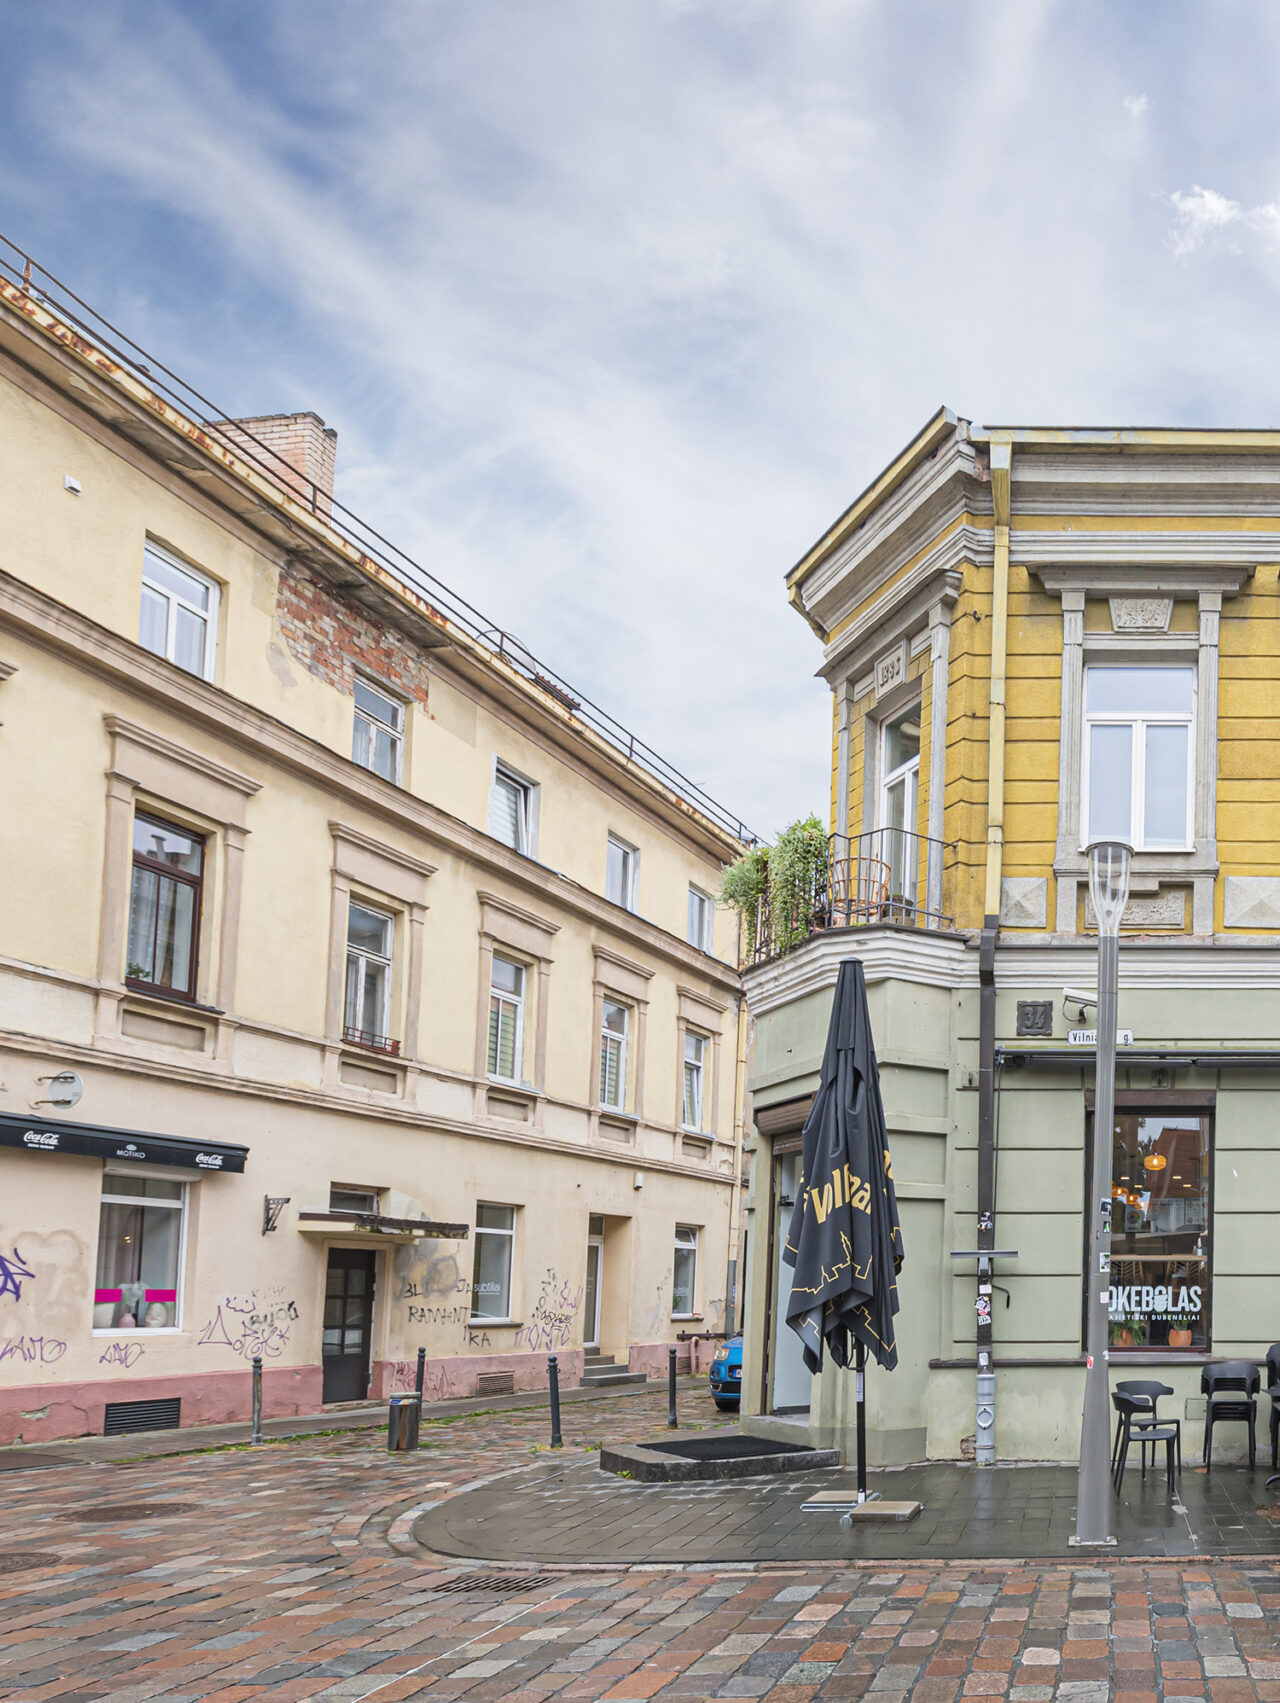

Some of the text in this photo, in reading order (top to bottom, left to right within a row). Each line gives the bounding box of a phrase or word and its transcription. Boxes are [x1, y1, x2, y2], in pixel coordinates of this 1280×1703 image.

[1023, 1006, 1046, 1028] 34
[116, 1149, 146, 1159] MOTIKO
[1108, 1285, 1202, 1313] OKEBOLAS
